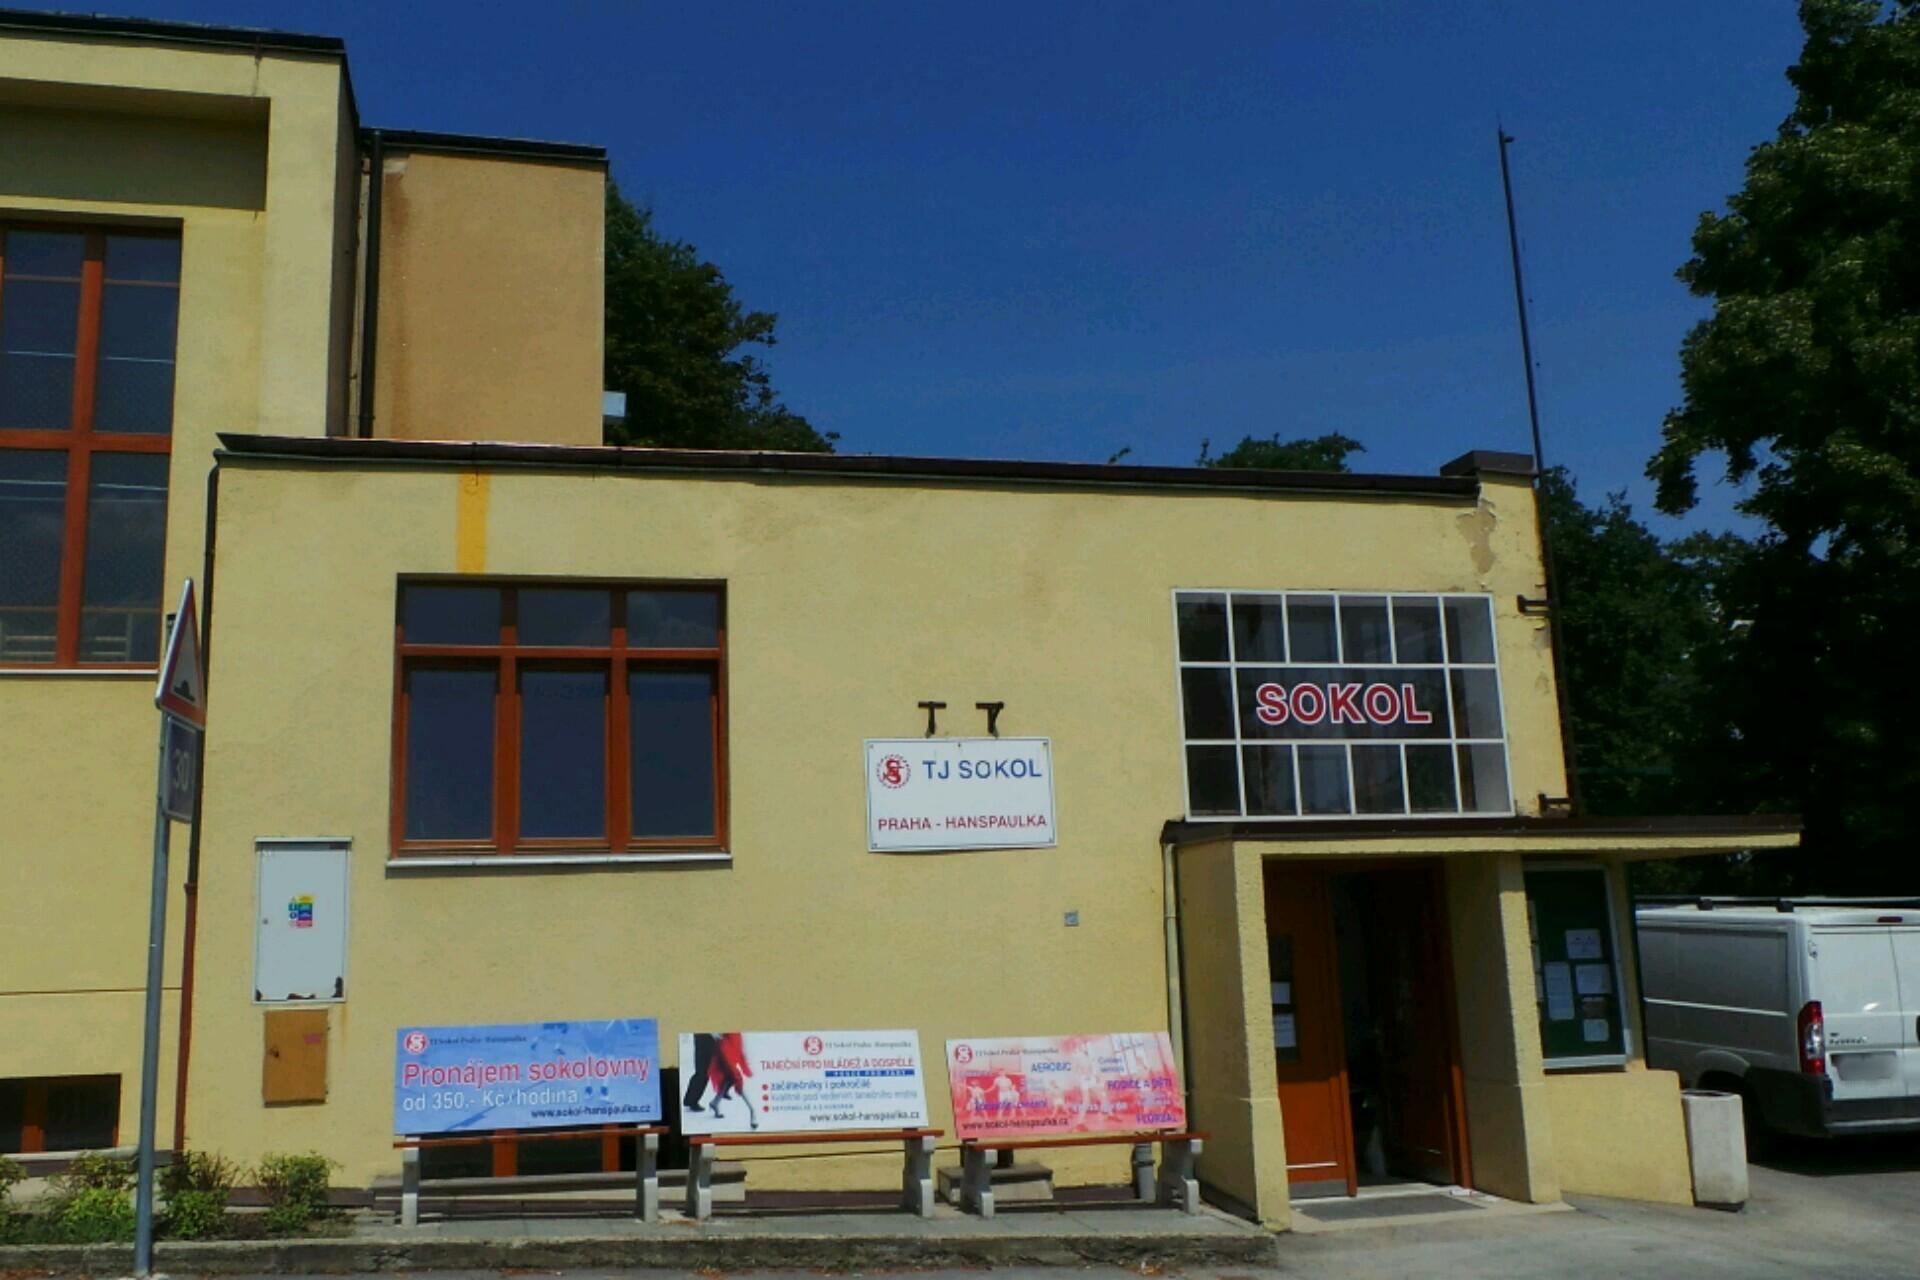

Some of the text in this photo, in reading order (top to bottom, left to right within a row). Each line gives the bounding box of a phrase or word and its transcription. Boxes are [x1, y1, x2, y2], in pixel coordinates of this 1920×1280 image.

[1256, 683, 1432, 725] SOKOL
[922, 760, 950, 780] TJ
[959, 758, 1043, 779] SOKOL
[878, 817, 932, 831] PRAHA
[945, 815, 1047, 829] HANSPAULKA
[402, 1055, 650, 1089] Pronájem sokolovny
[403, 1094, 426, 1111] od
